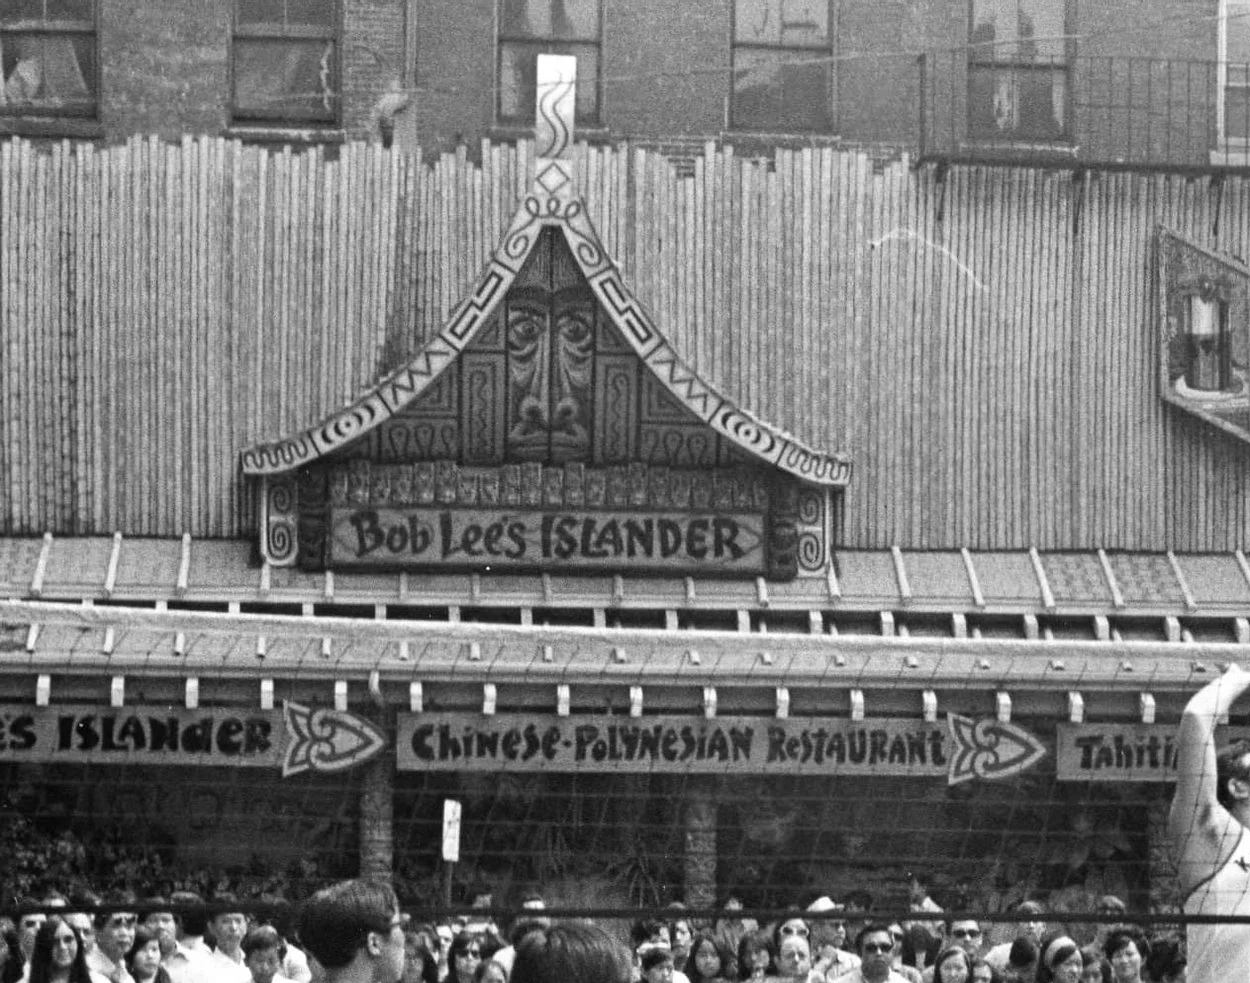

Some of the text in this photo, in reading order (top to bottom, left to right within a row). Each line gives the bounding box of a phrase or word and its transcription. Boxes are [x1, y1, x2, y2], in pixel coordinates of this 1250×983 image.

[350, 510, 743, 561] Bob Lee's ISLANDER
